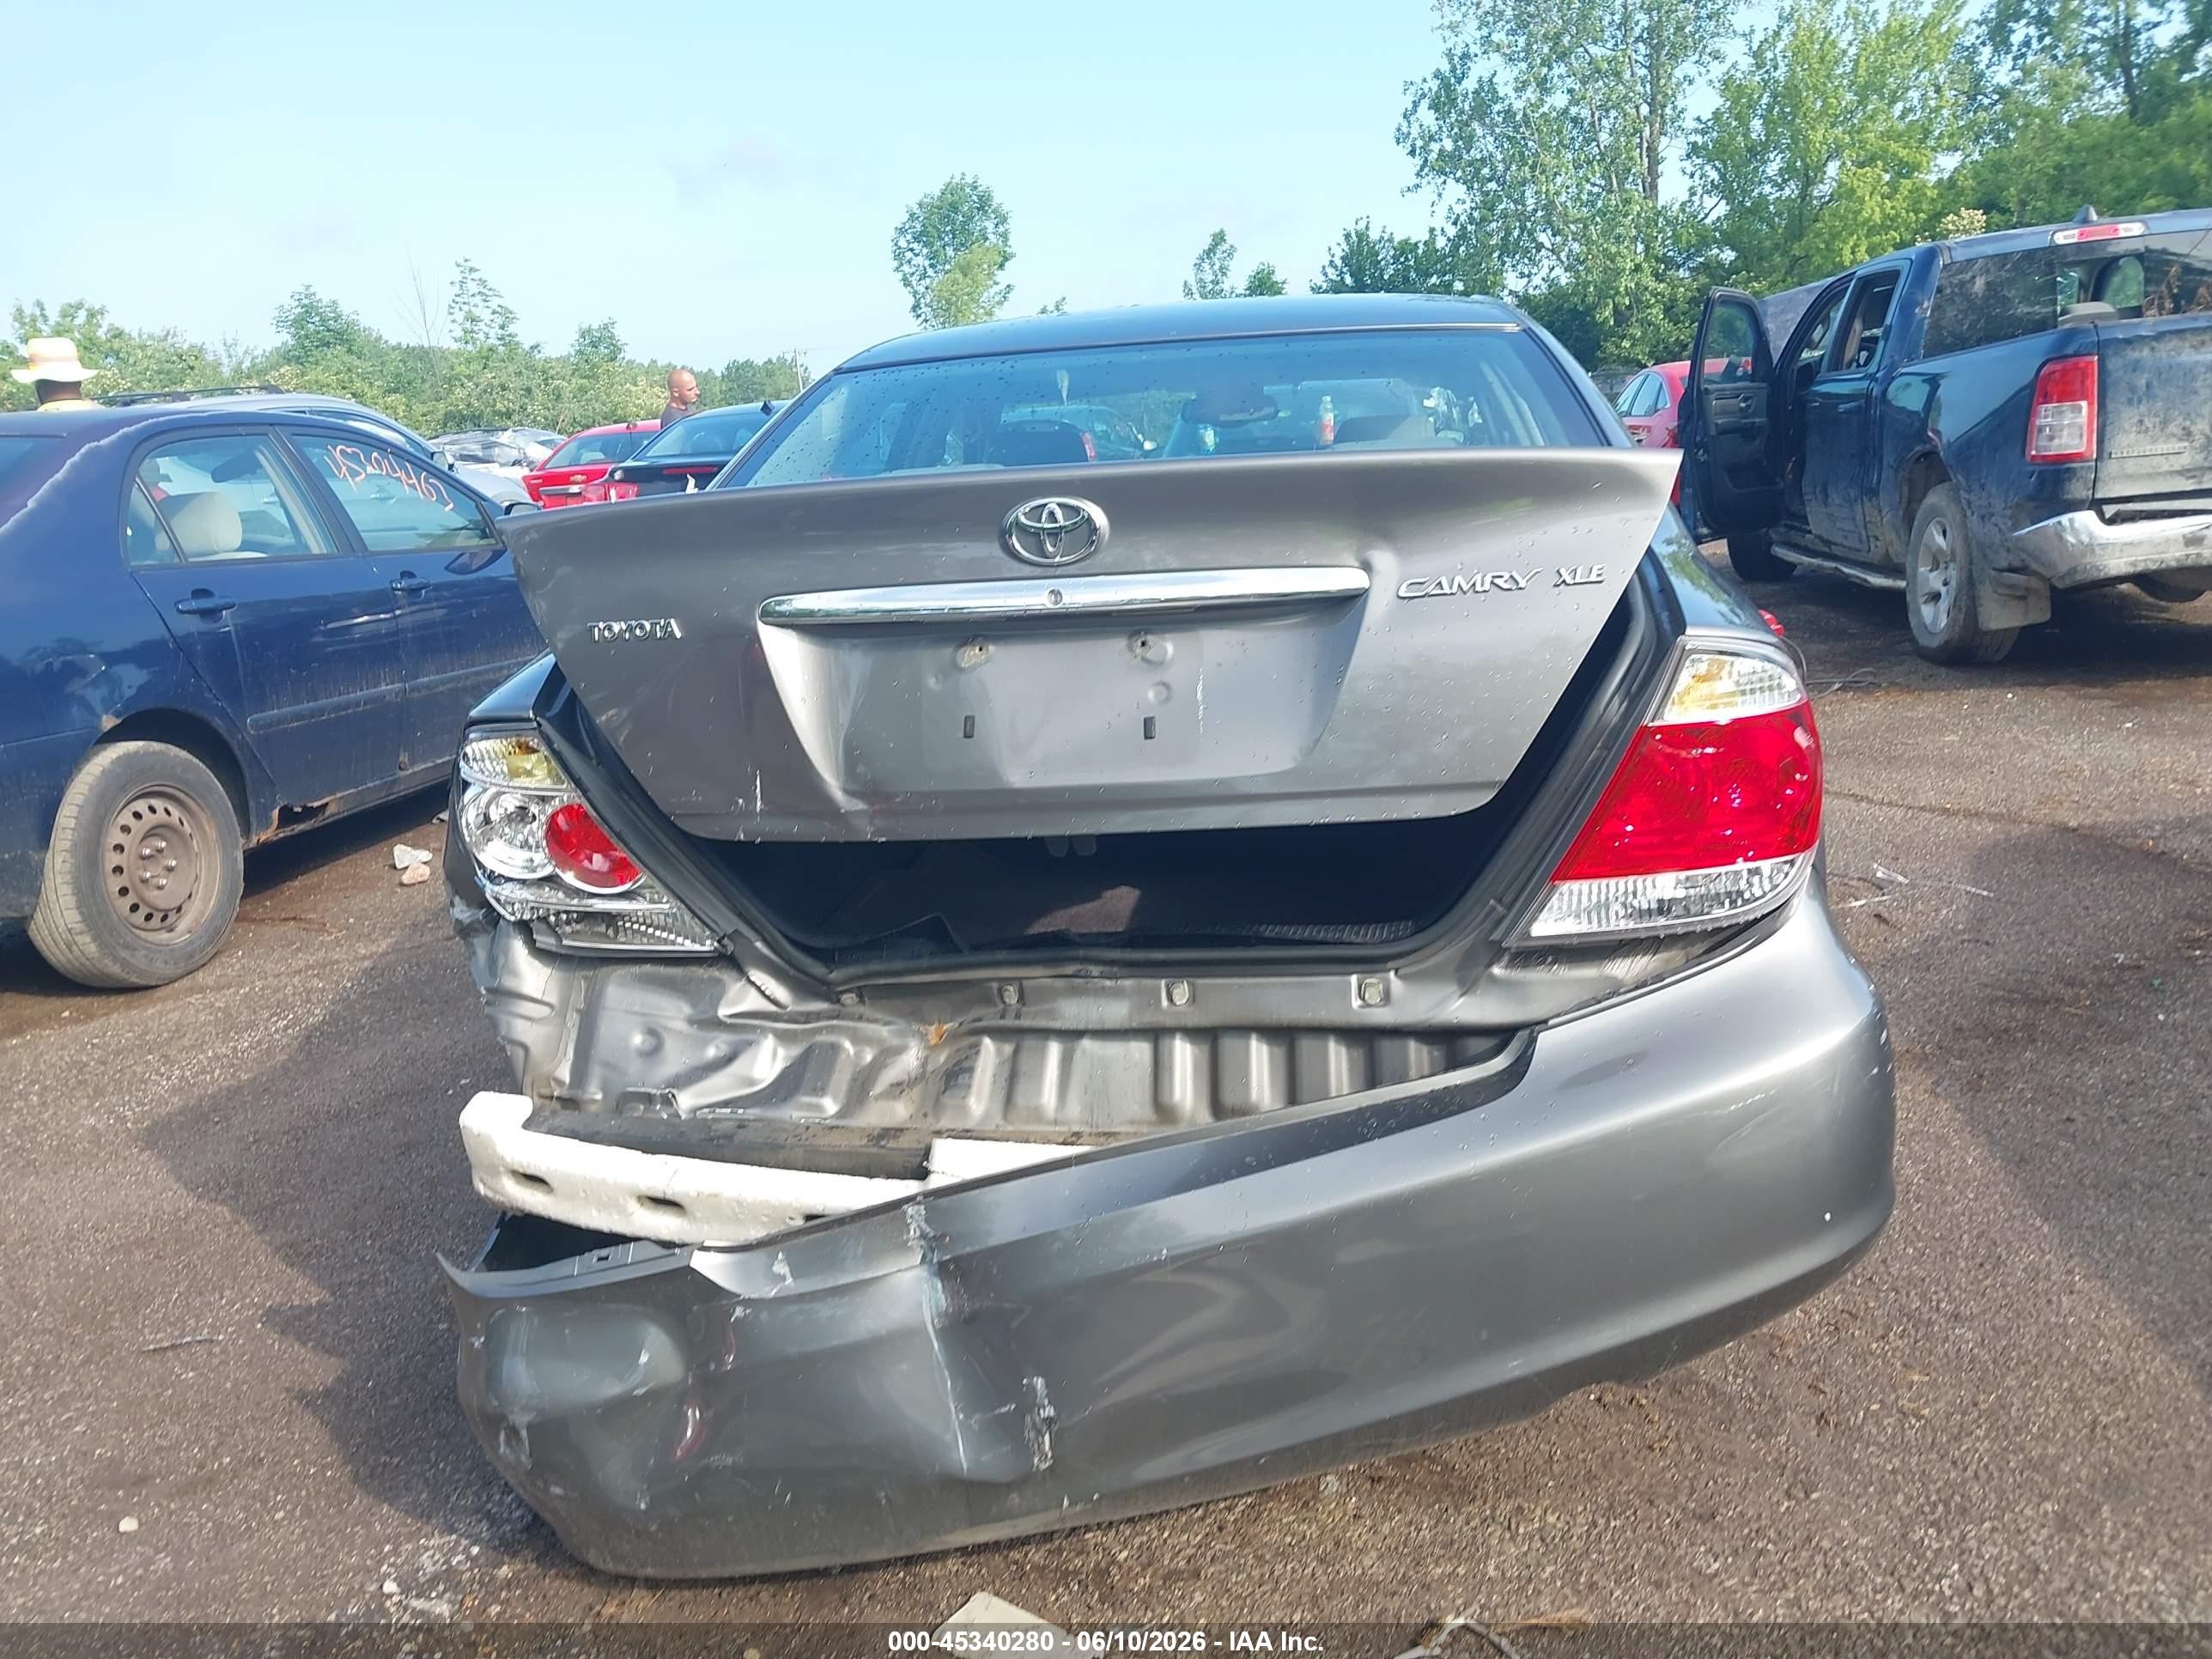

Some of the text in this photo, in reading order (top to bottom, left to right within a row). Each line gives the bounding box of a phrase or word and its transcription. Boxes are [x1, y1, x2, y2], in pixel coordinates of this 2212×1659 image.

[1397, 563, 1607, 599] CAMRY XLE
[586, 617, 682, 642] TOYOTA
